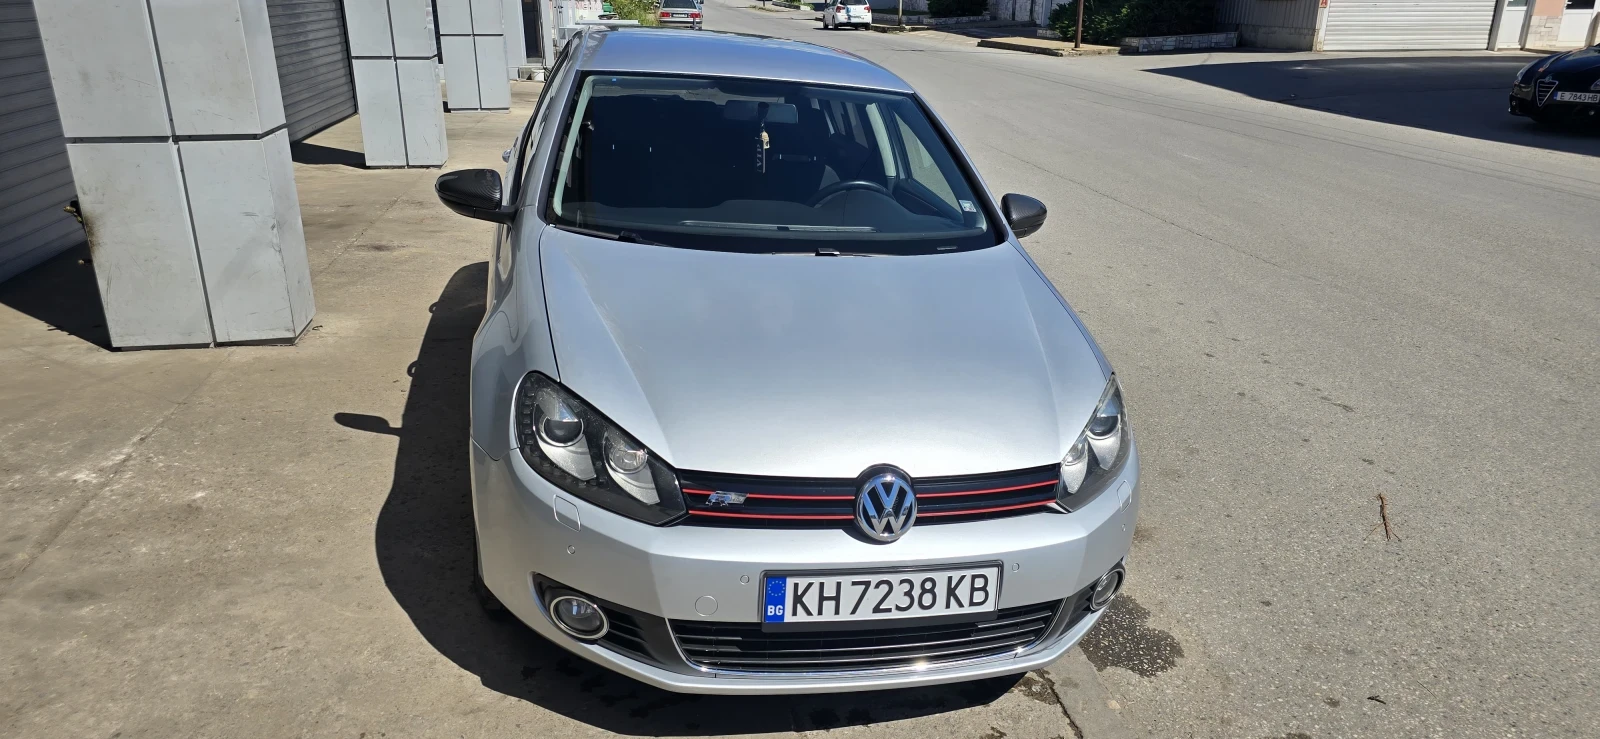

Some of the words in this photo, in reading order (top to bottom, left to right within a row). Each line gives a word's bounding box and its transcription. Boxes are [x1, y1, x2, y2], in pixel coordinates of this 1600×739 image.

[1560, 92, 1565, 100] E
[1568, 93, 1587, 101] 7843
[1587, 94, 1598, 102] HB
[791, 581, 842, 617] KH
[849, 576, 937, 616] 7238
[944, 573, 990, 610] KB
[767, 604, 784, 617] BG
